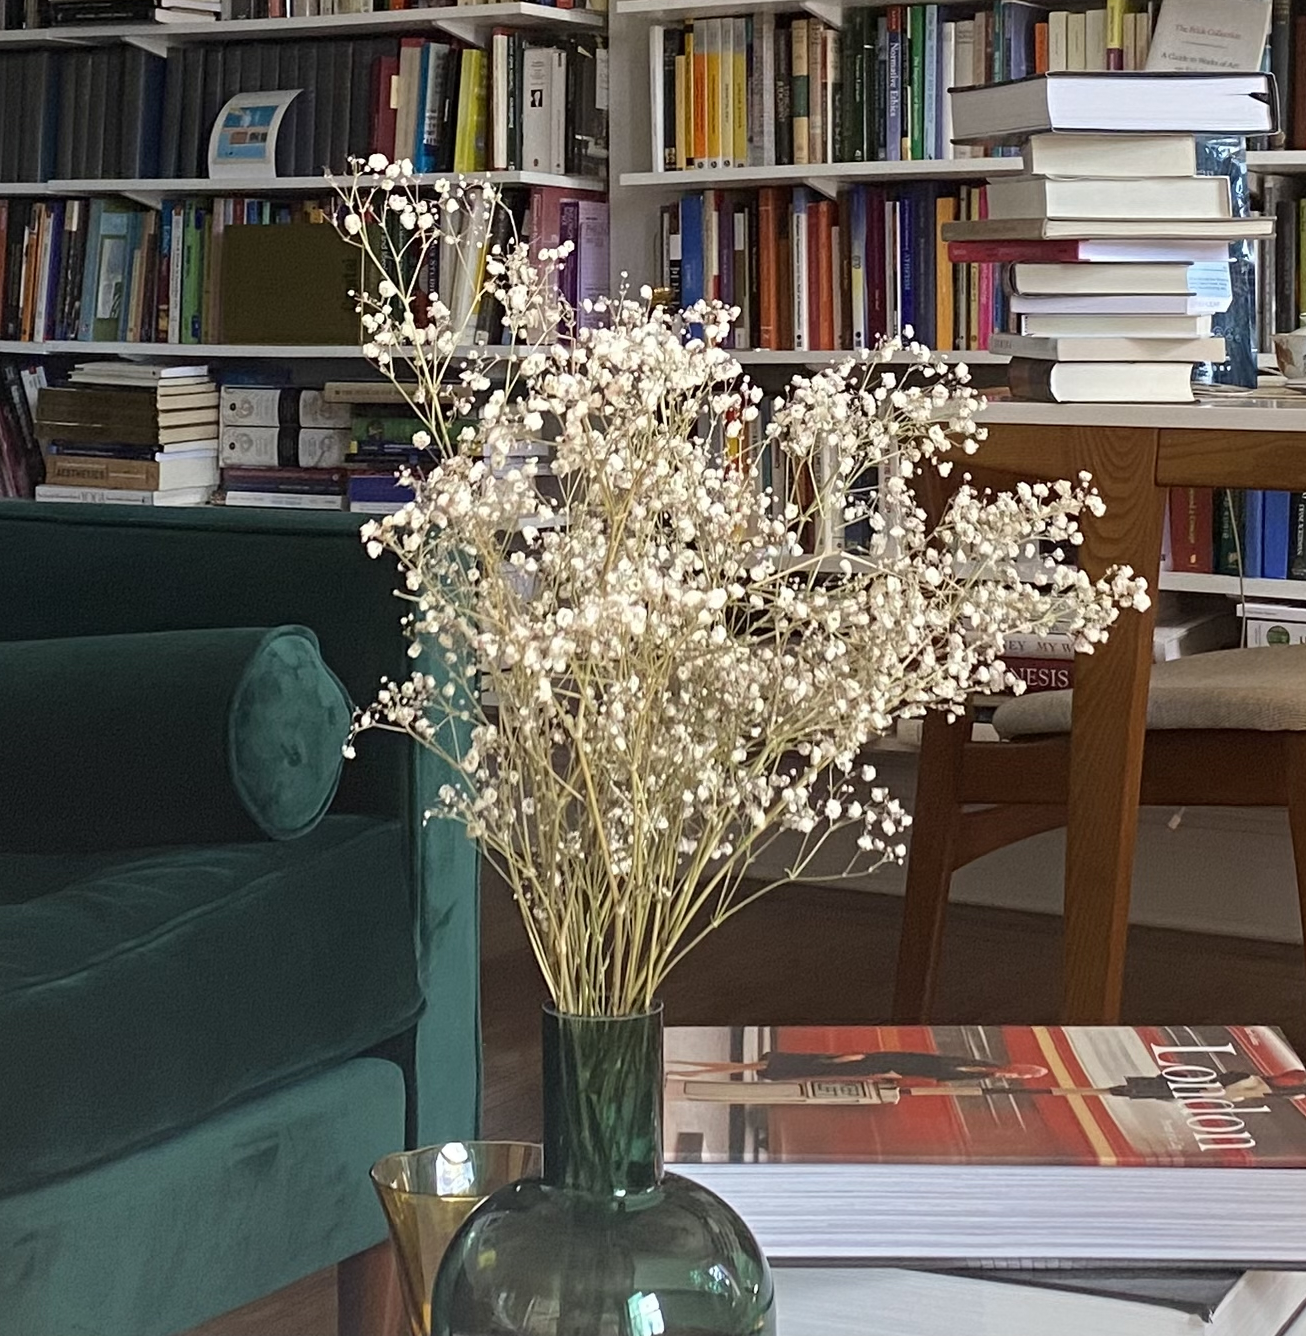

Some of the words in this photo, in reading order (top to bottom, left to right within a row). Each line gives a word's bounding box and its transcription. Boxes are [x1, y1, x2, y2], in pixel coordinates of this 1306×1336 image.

[889, 43, 899, 88] Normative
[1198, 58, 1218, 66] Works
[890, 90, 899, 117] Ethics
[1150, 1042, 1271, 1152] London
